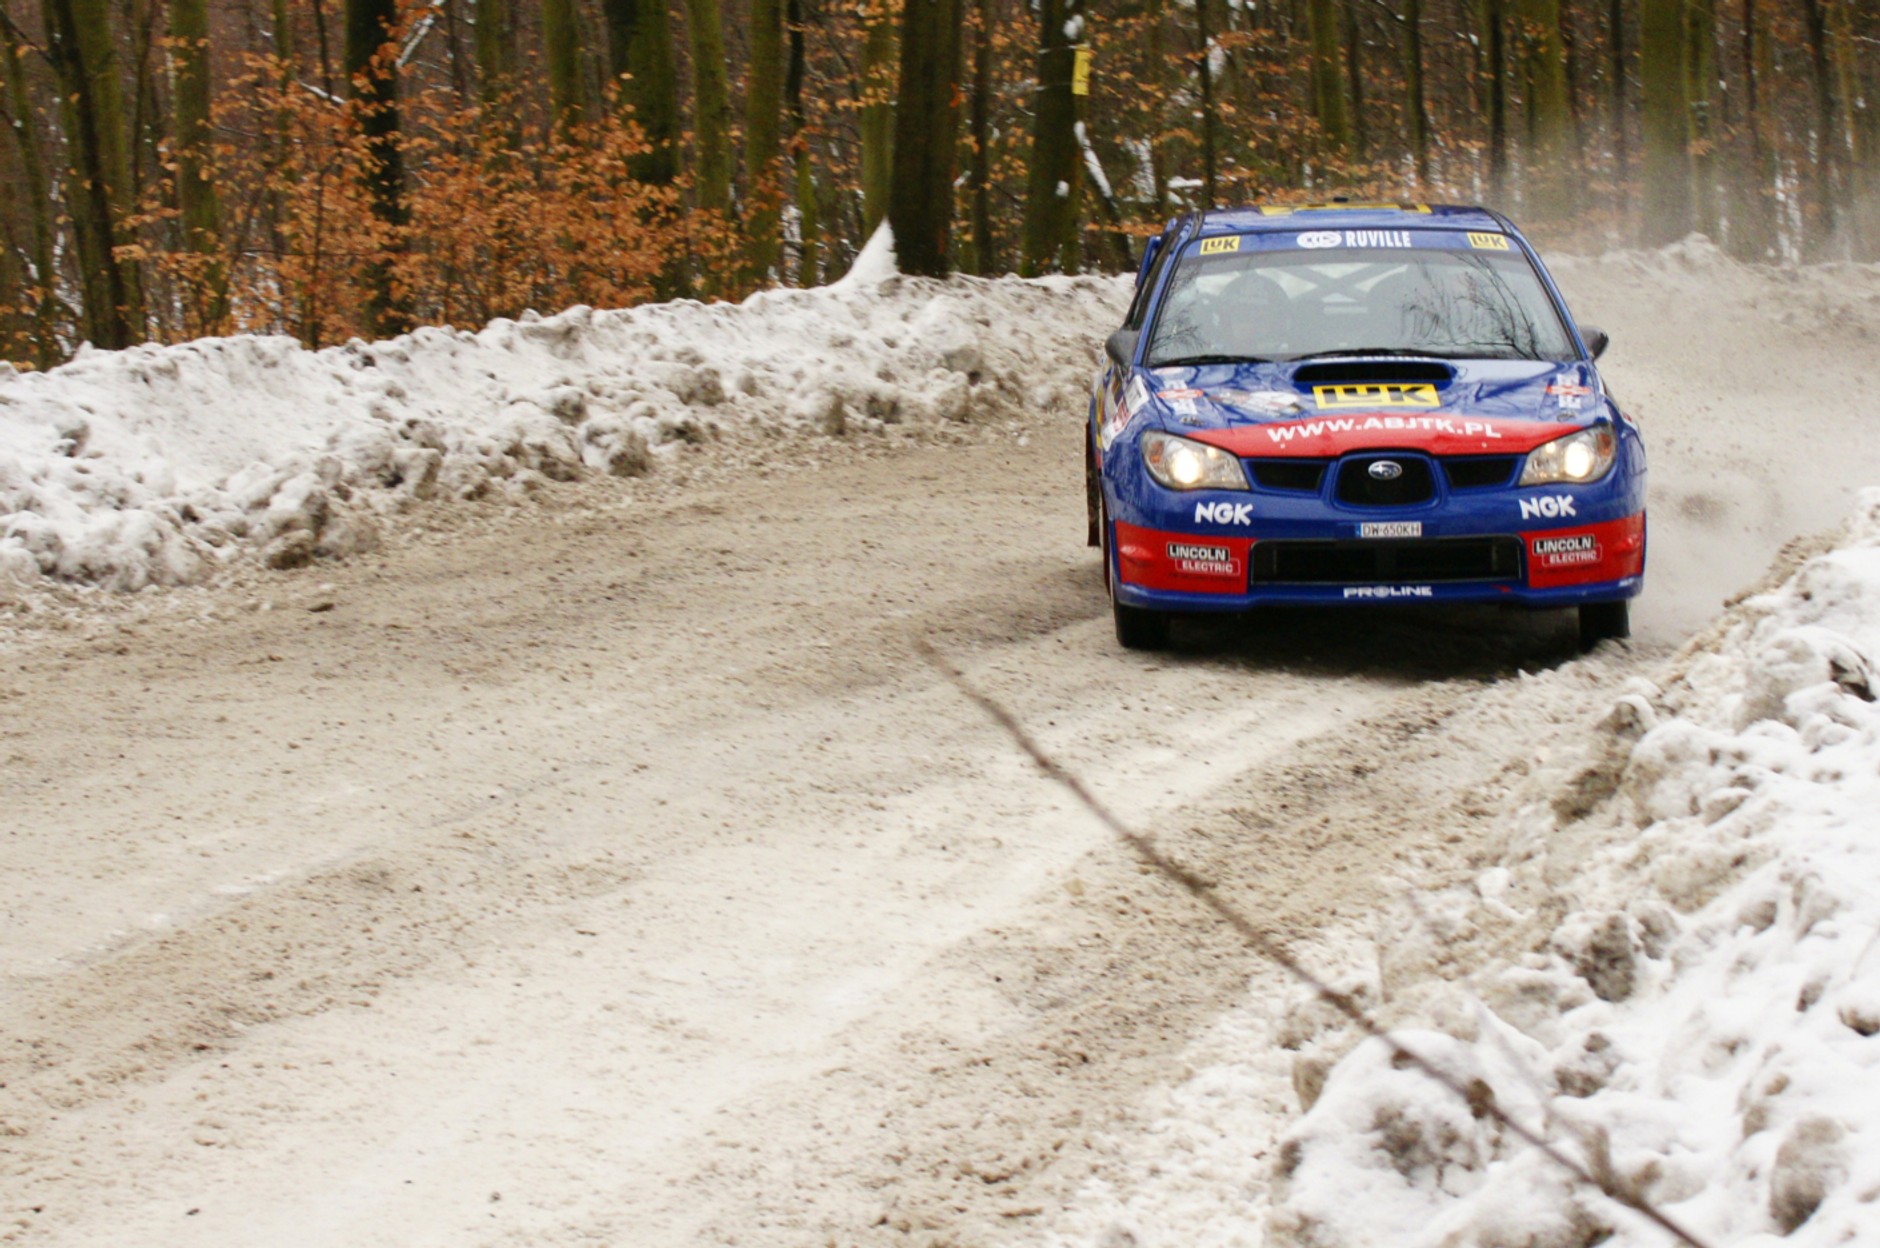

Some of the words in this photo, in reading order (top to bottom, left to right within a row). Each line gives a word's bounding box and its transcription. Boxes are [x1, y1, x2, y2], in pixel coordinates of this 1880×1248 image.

[1345, 230, 1412, 248] RUVILLE
[1266, 416, 1502, 443] WWW.ABJTK.PL
[1194, 501, 1254, 527] NGK
[1518, 494, 1577, 520] NGK
[1168, 543, 1226, 560] LINCOLN
[1535, 536, 1592, 554] LINCOLN
[1549, 549, 1598, 565] ELECTRIC
[1182, 560, 1234, 574] ELECTRIC
